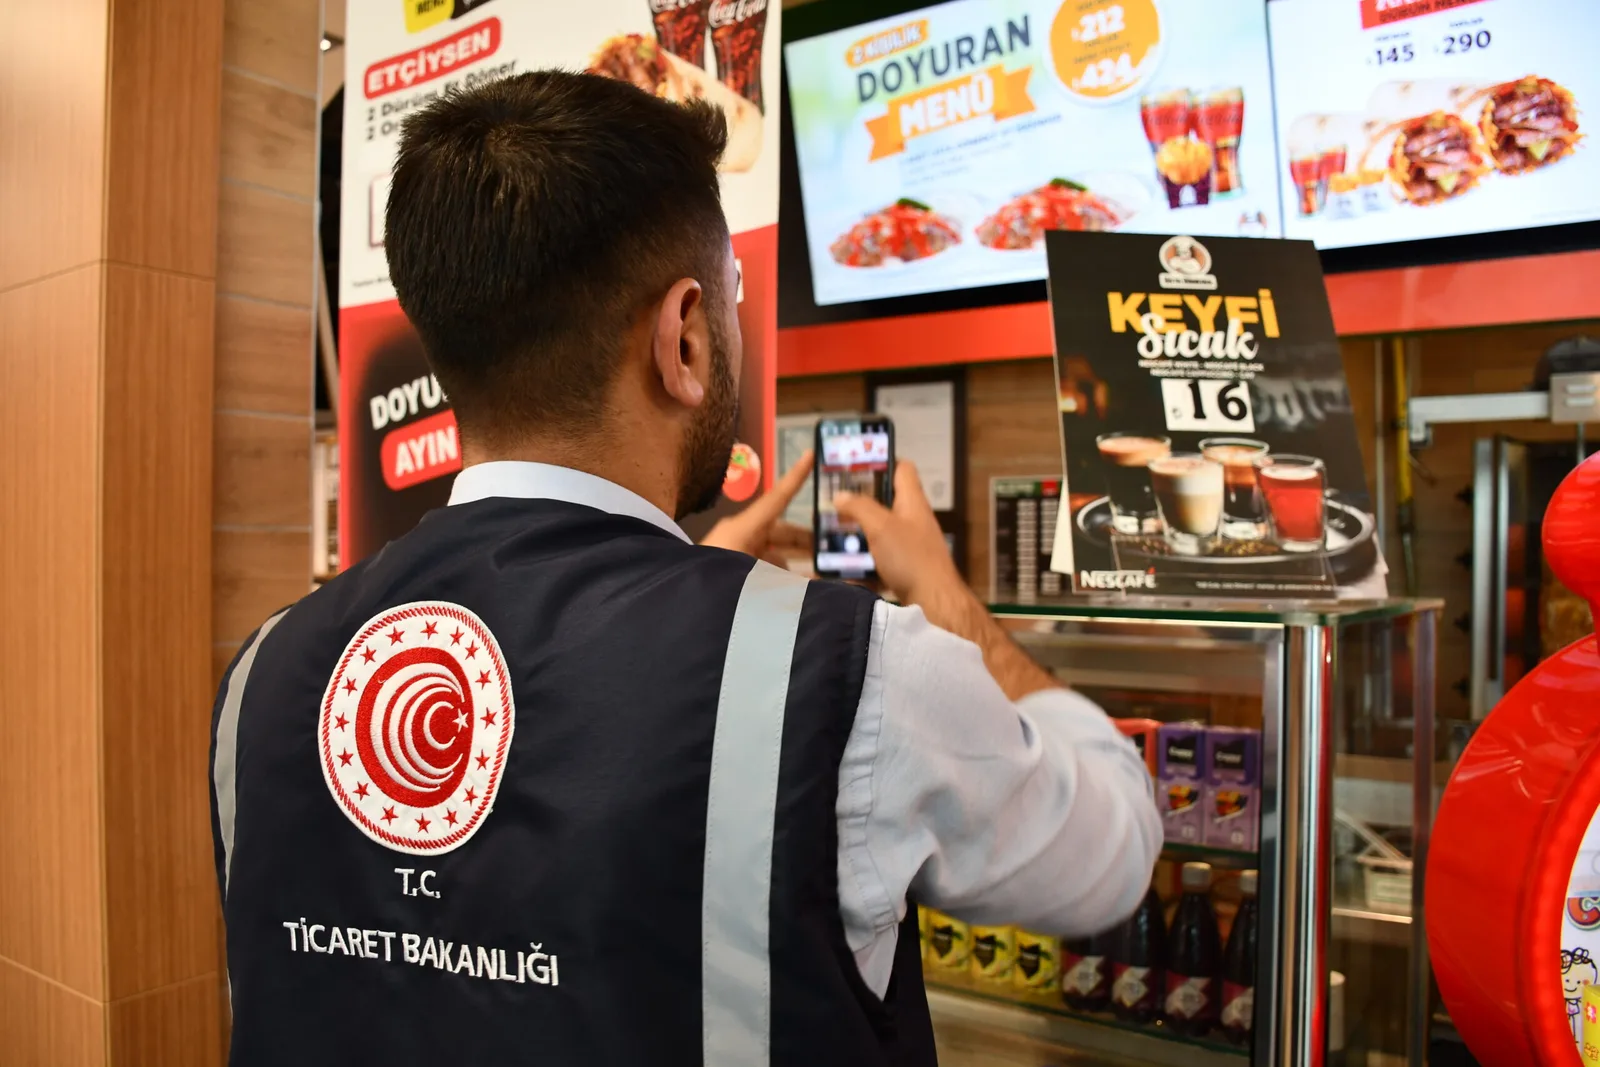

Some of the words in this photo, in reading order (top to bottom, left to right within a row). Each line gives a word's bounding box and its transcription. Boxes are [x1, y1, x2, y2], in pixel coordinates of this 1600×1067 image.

[368, 27, 491, 92] ETÇİYSEN
[858, 15, 1030, 103] DOYURAN
[1376, 43, 1414, 65] 145
[1443, 30, 1491, 54] 290
[899, 73, 994, 137] MENÜ
[1107, 288, 1280, 338] KEYFİ
[1137, 312, 1259, 360] Sıcak
[370, 372, 449, 430] DOYU
[1188, 379, 1248, 420] 16
[395, 426, 458, 477] AYIN
[394, 867, 441, 899] T.C.
[283, 917, 396, 962] TİCARET
[402, 933, 559, 986] BAKANLIĞI
